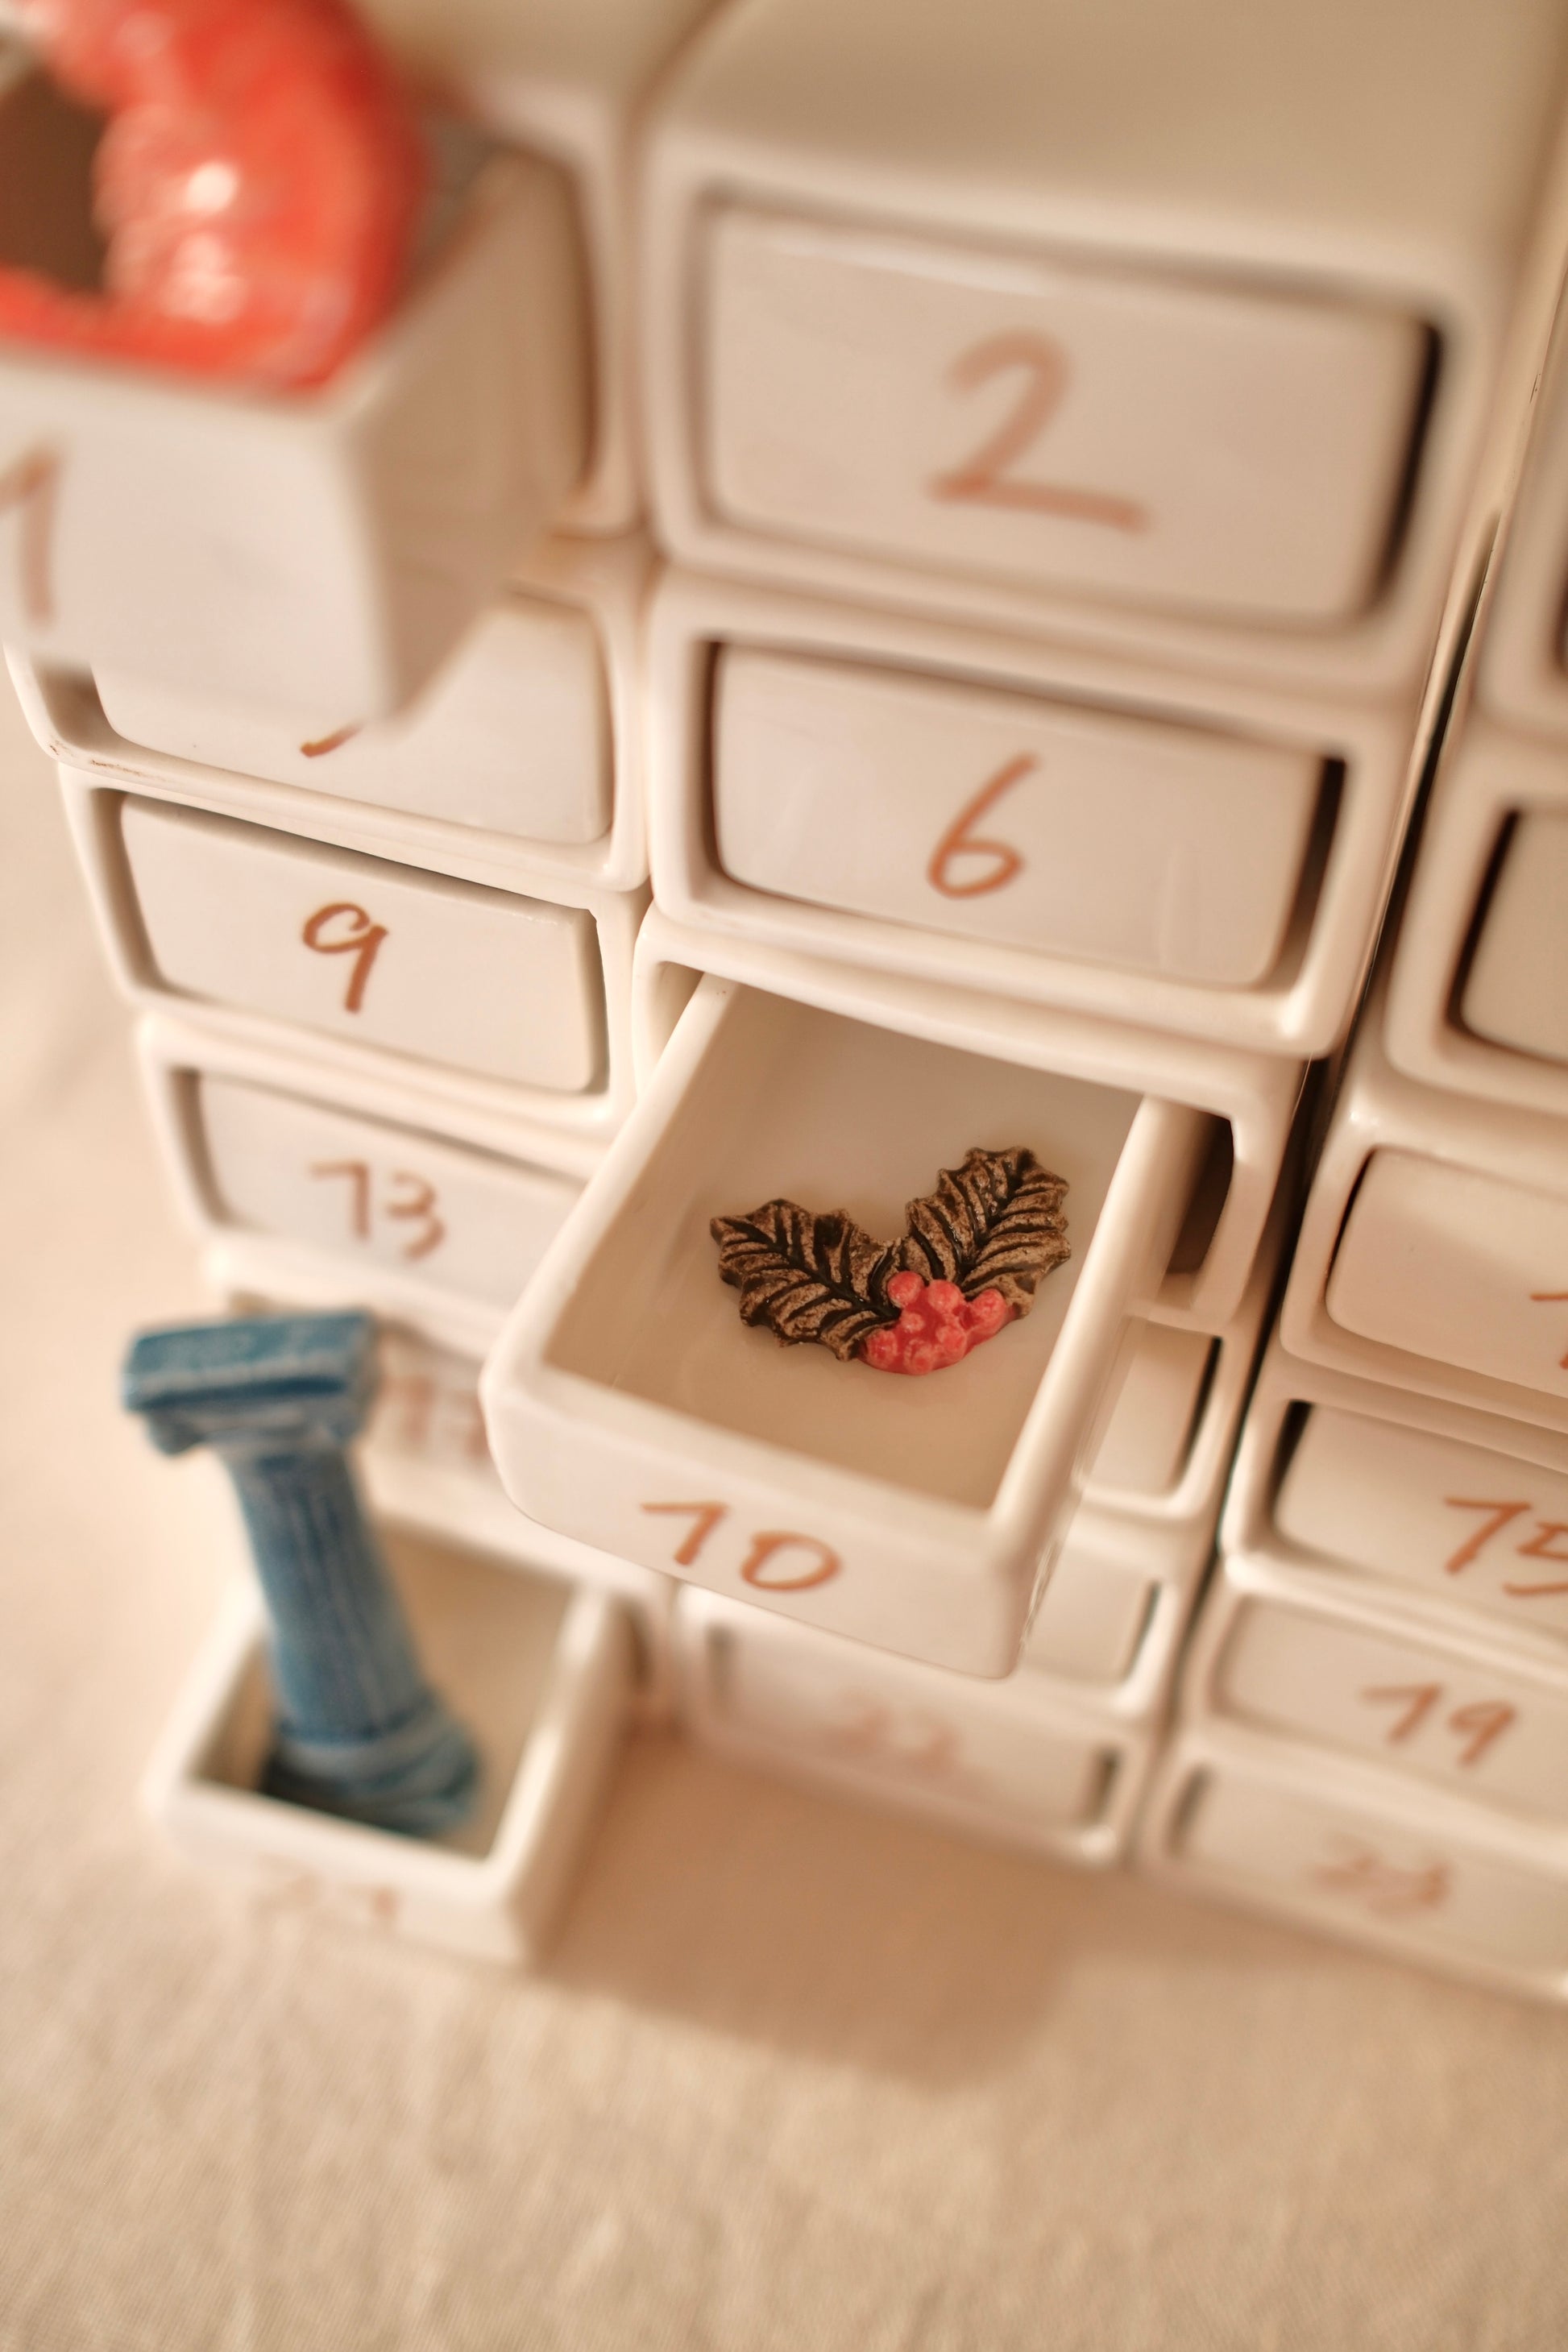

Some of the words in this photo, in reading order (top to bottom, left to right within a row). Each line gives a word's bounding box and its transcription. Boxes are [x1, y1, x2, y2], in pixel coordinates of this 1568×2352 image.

[929, 326, 1150, 533] 2
[926, 752, 1039, 899] 6
[301, 902, 389, 1014] 9
[309, 1159, 446, 1263] 13
[641, 1501, 844, 1592] 10
[1362, 1682, 1518, 1766] 19
